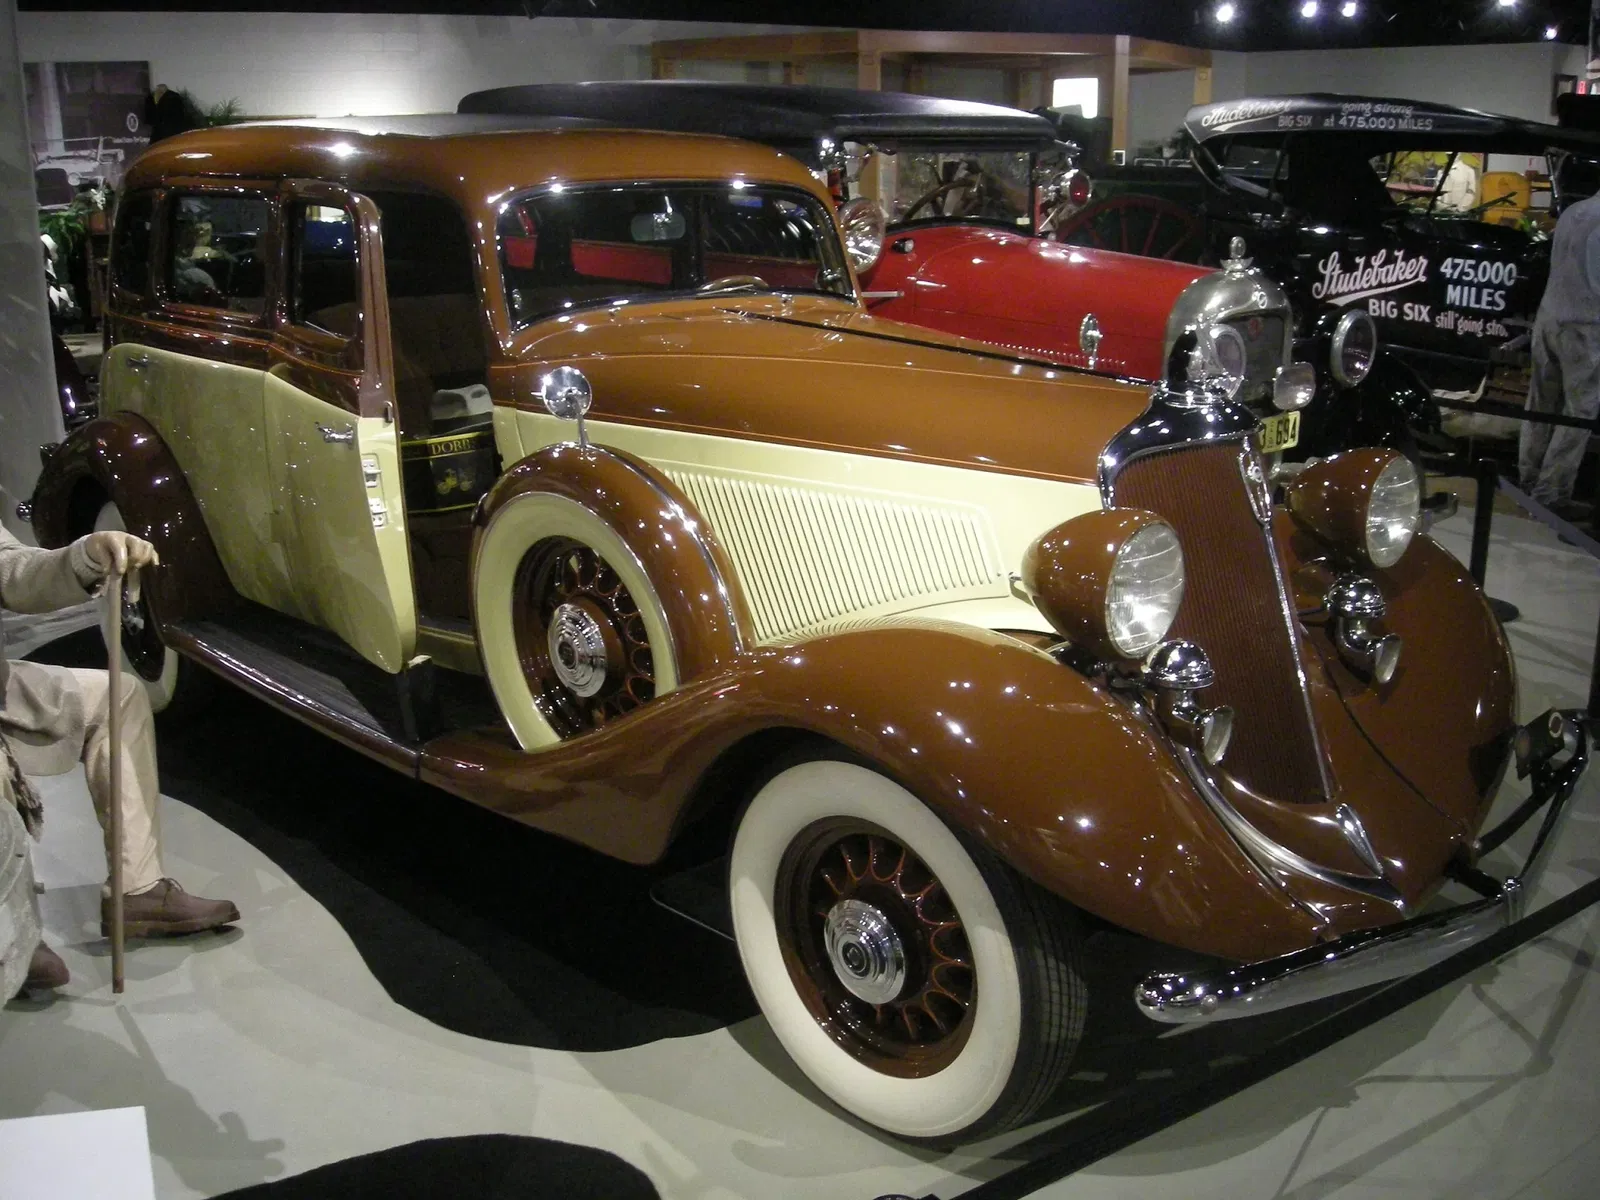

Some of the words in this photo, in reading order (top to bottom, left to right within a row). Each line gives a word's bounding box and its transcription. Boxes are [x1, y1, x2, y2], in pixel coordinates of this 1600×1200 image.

[1201, 99, 1293, 129] Studebaker
[1278, 115, 1295, 127] BIG
[1295, 115, 1313, 127] SIX
[1398, 117, 1433, 130] MILES
[1341, 102, 1372, 117] going
[1373, 103, 1415, 119] strong
[1312, 248, 1429, 300] Studebaker
[1439, 257, 1517, 287] 475,000
[1368, 298, 1398, 318] BIG
[1403, 302, 1431, 323] SIX
[1446, 284, 1506, 311] MILES
[1435, 310, 1455, 330] still
[1457, 315, 1484, 338] going
[1485, 319, 1509, 338] stro
[1276, 416, 1297, 446] 694
